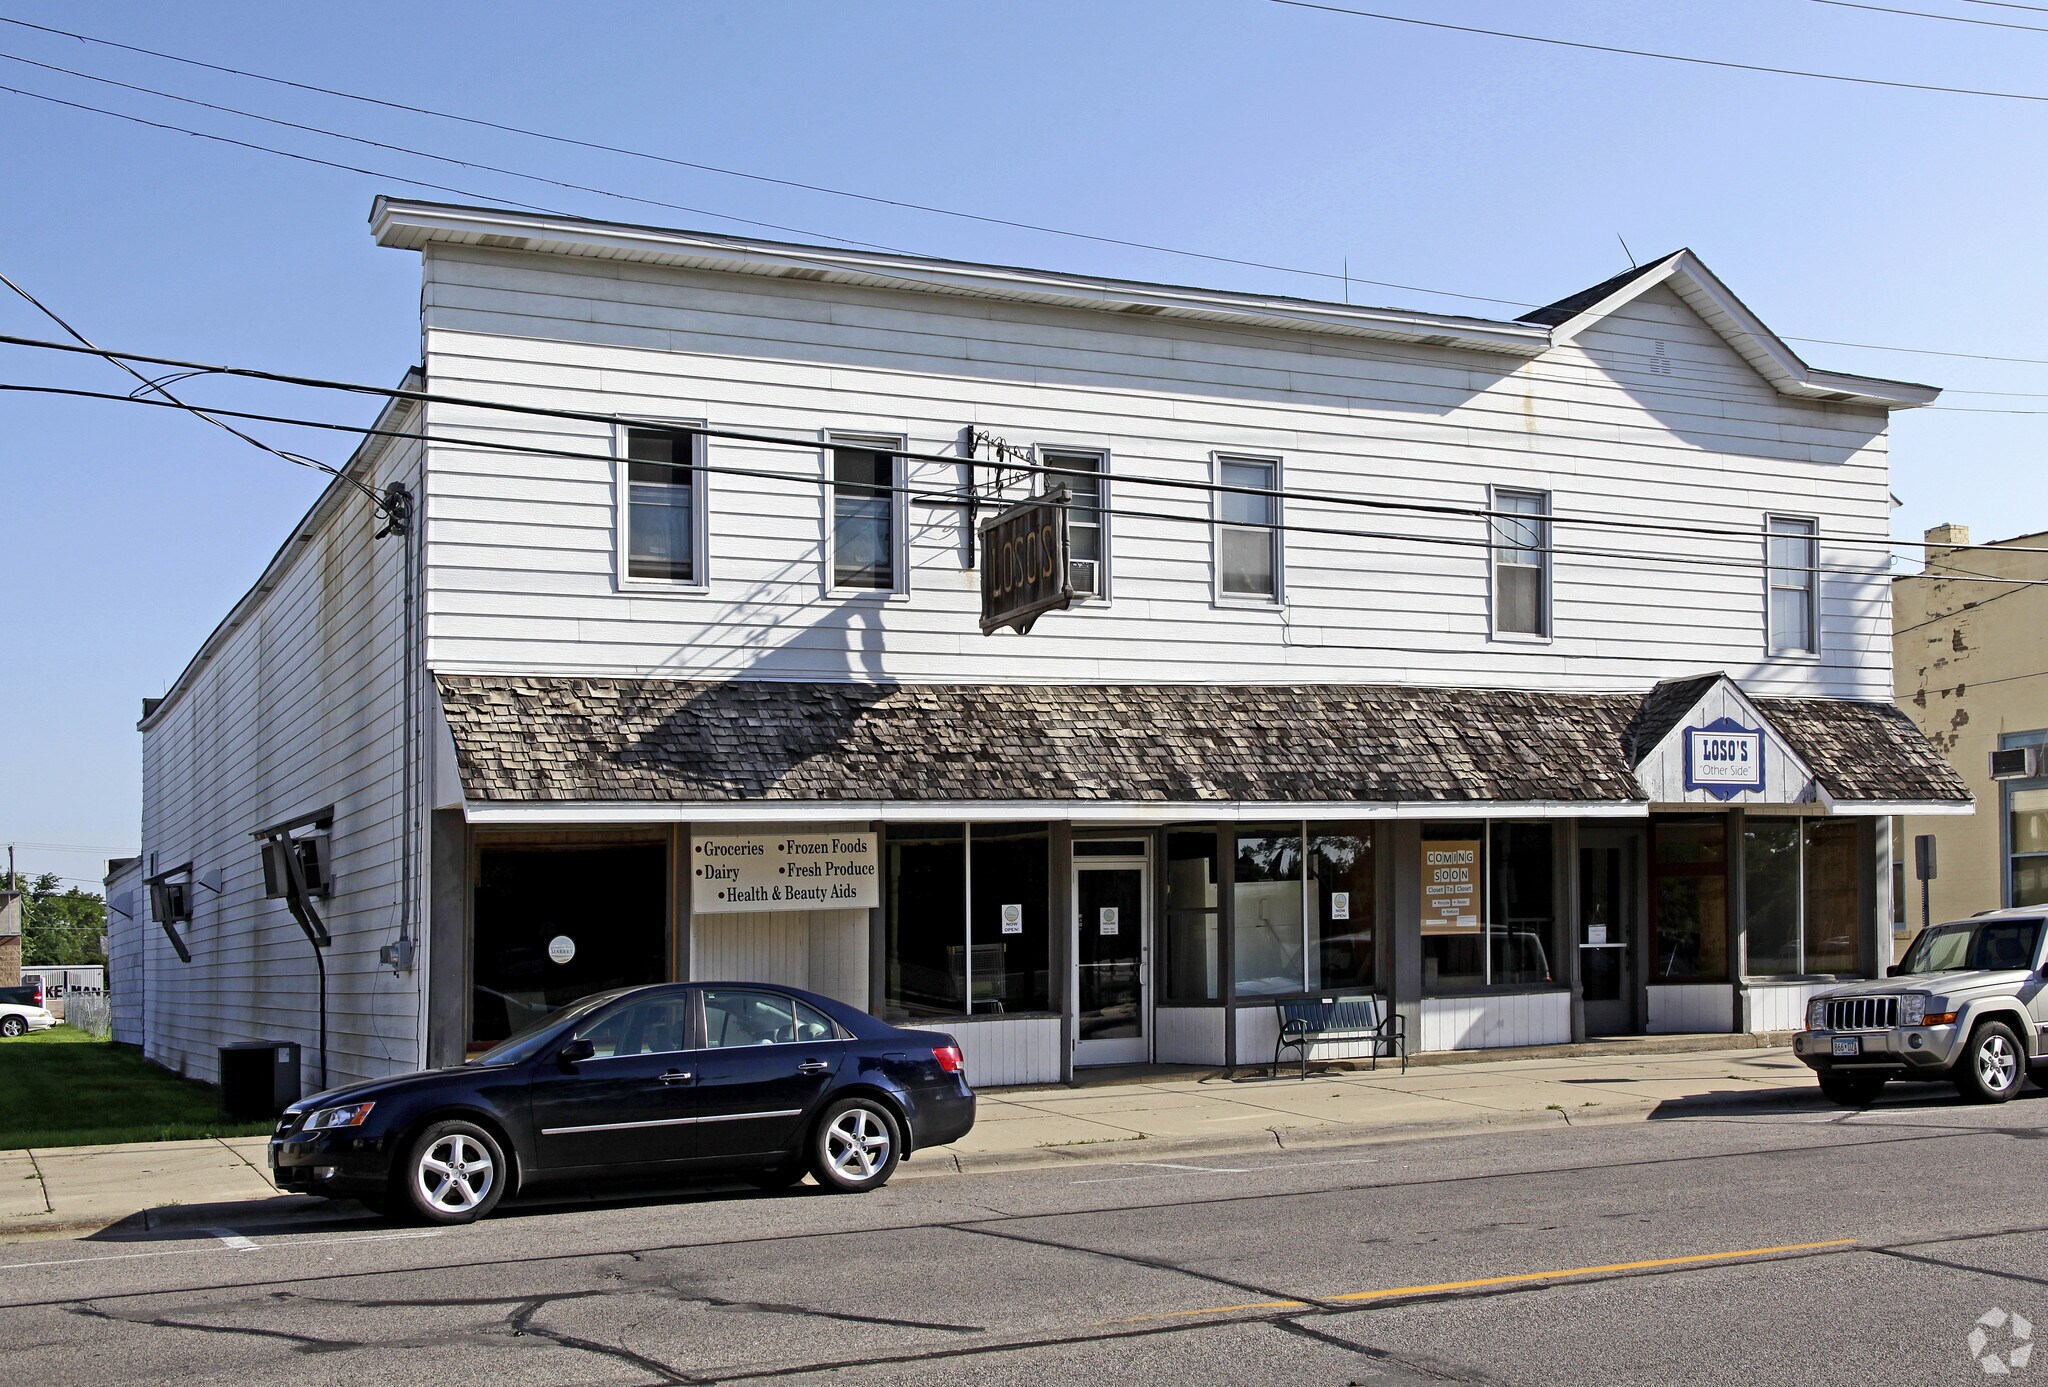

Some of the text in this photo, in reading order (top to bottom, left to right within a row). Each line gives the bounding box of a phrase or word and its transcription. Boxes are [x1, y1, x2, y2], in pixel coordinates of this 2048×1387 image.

[992, 525, 1052, 597] LOSO'S
[1703, 739, 1748, 762] LOSO'S
[1700, 764, 1751, 776] "Other Side"
[704, 840, 764, 856] Groceries
[786, 838, 867, 855] Frozen Foods
[1428, 853, 1473, 863] COMING
[704, 864, 739, 882] Dairy
[787, 861, 875, 878] Fresh Produce
[1435, 871, 1468, 881] SOON
[727, 883, 857, 902] Health & Beauty Aids
